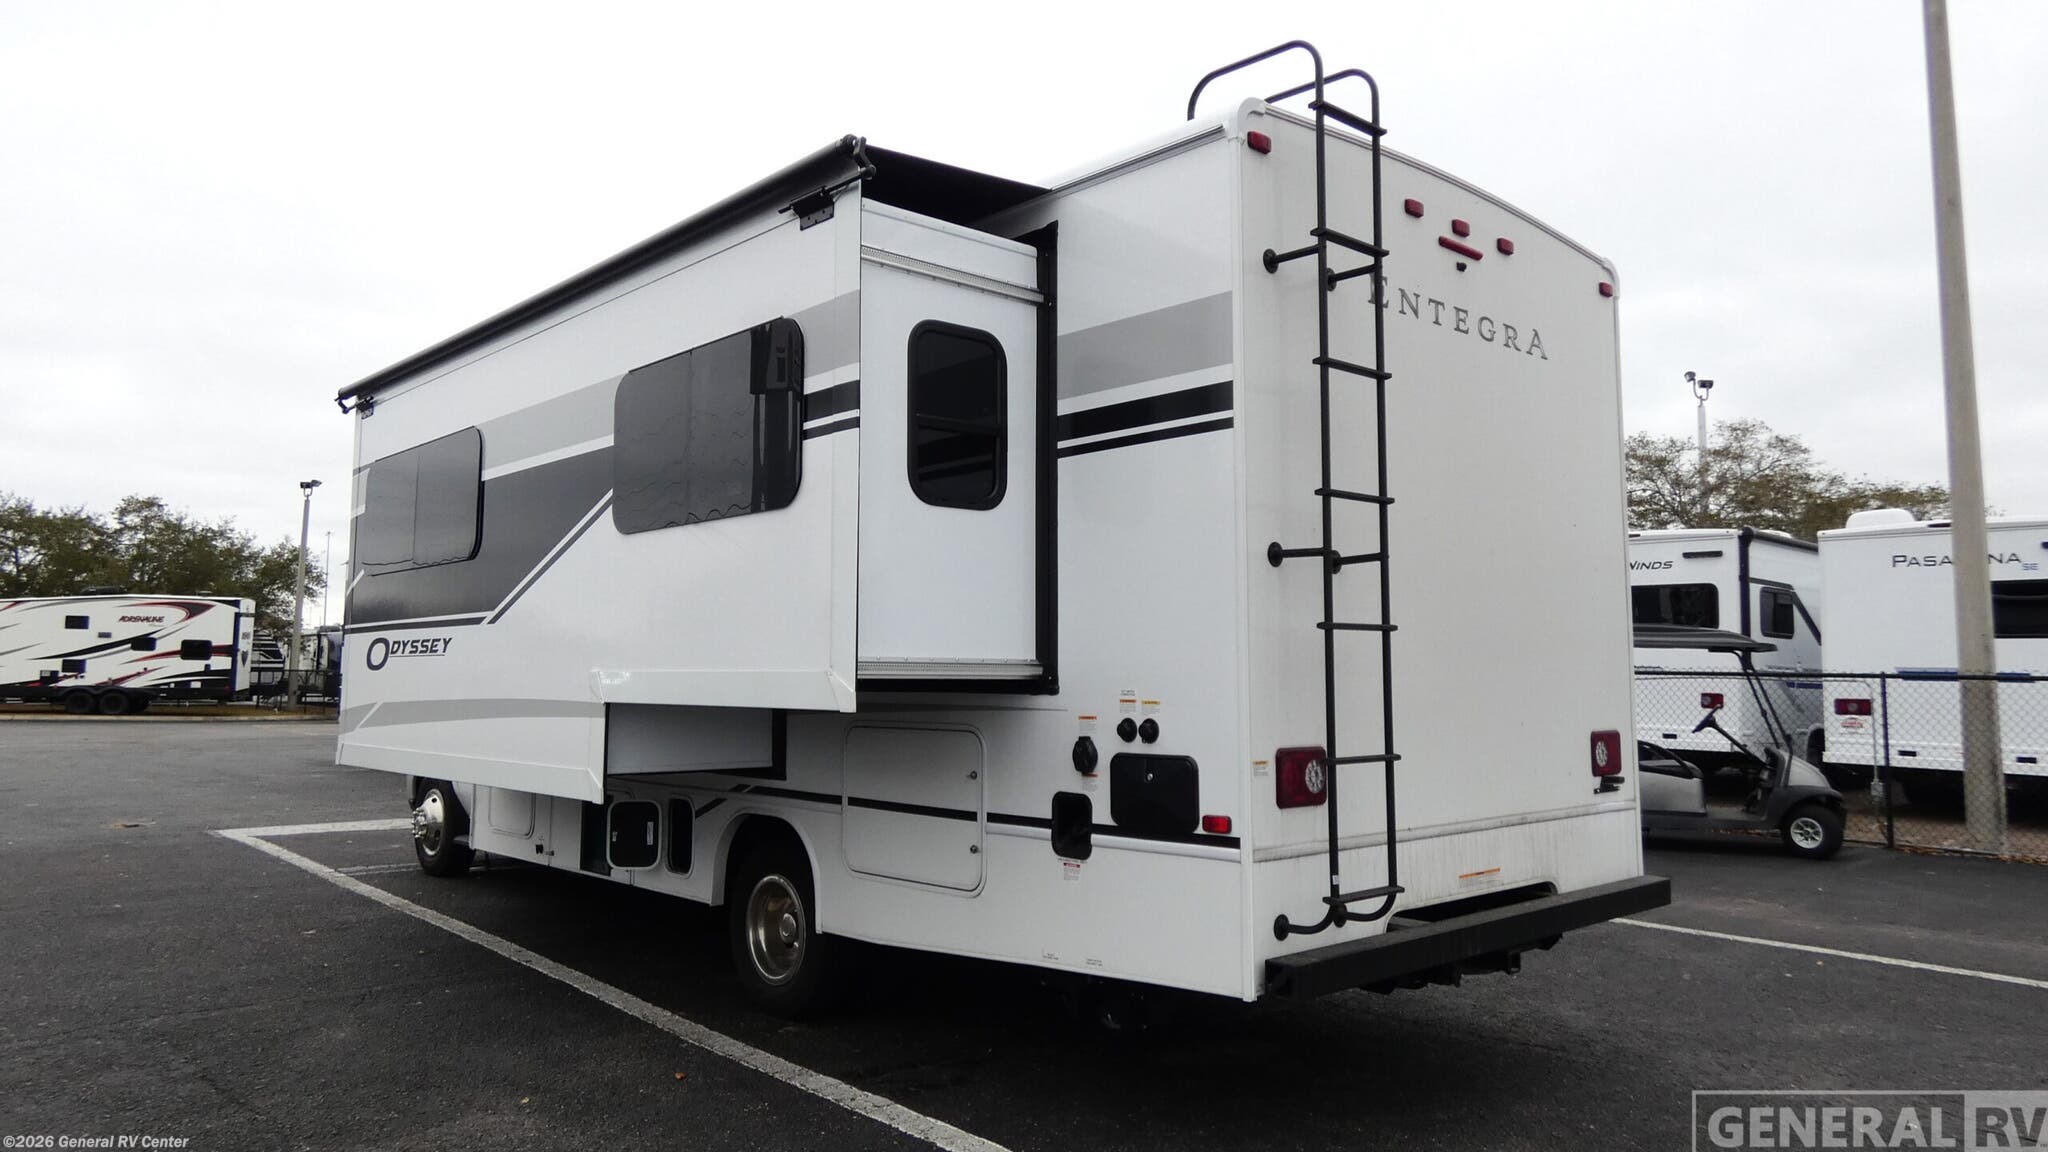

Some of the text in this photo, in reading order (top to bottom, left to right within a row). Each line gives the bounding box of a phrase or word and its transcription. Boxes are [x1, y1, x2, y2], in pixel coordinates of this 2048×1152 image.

[1367, 273, 1548, 360] ENTEGRA
[1892, 553, 2022, 567] PASANA
[366, 637, 453, 671] ODYSSEY
